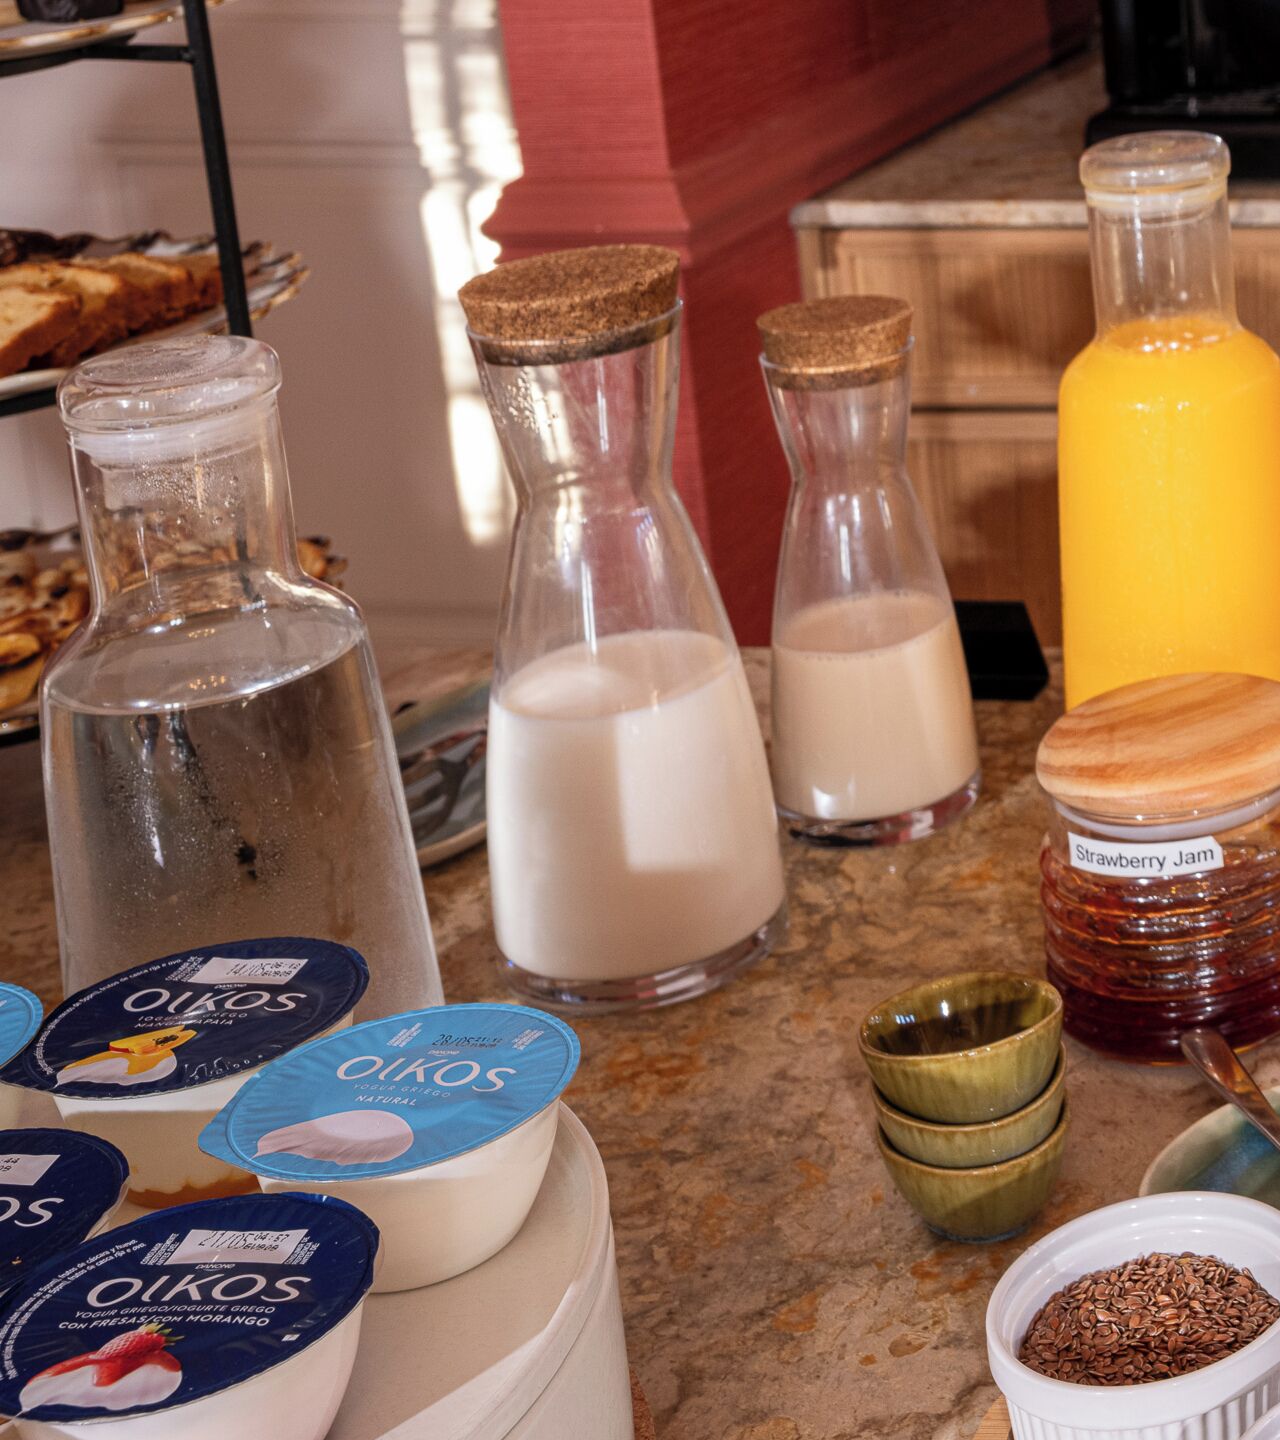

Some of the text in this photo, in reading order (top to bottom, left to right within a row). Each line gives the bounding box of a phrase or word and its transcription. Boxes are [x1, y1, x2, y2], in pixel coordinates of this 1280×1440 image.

[1076, 844, 1215, 872] Strawberry Jam
[123, 988, 307, 1013] OIKOS
[336, 1056, 517, 1093] OIKOS
[353, 1082, 450, 1098] YOGUR GRIEGO
[355, 1095, 416, 1106] NATURAL
[87, 1273, 311, 1308] OIKOS
[58, 1314, 270, 1329] CON FRESAS/COM MORANGO
[75, 1304, 276, 1319] YOGUR GRIEGO/IOGURTE GREGO
